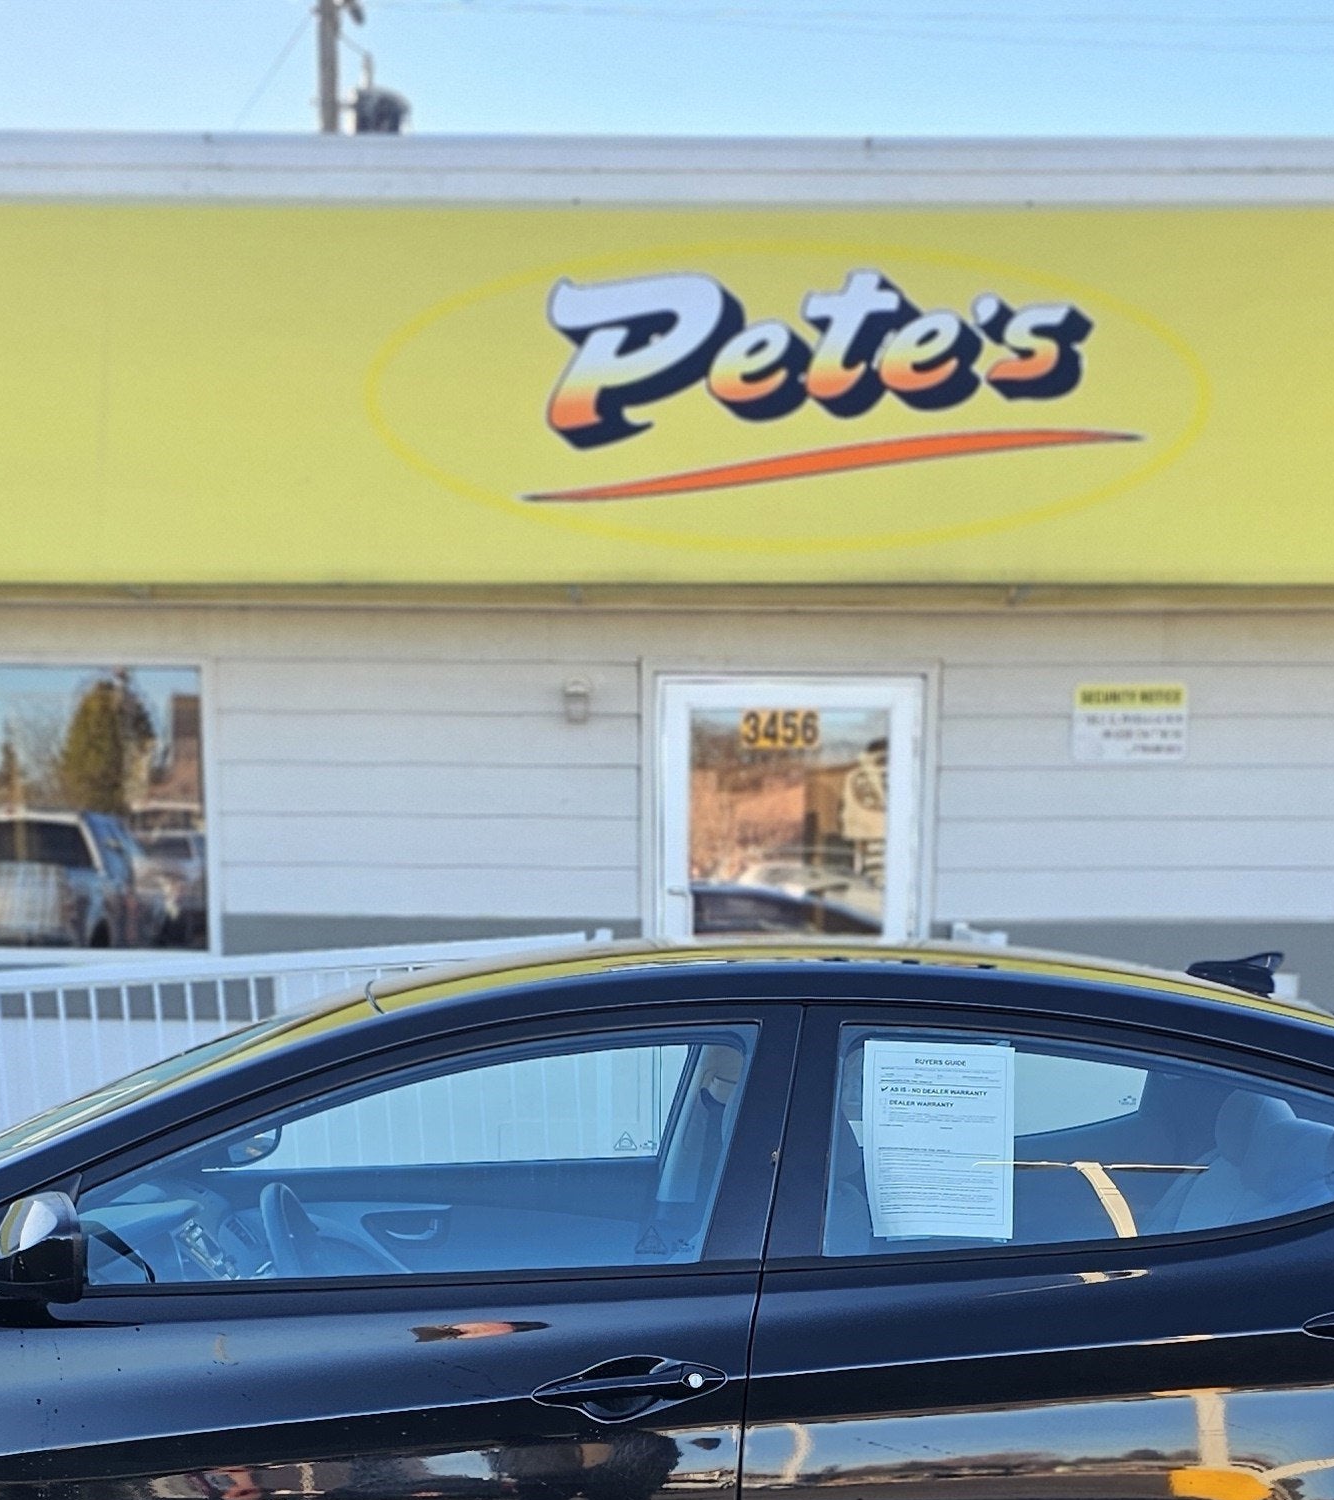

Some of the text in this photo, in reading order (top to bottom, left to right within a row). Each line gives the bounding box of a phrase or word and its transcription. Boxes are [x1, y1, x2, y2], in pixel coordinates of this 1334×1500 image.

[547, 268, 1094, 451] Pete's
[742, 710, 819, 745] 3456
[950, 1089, 988, 1097] WARRANTY
